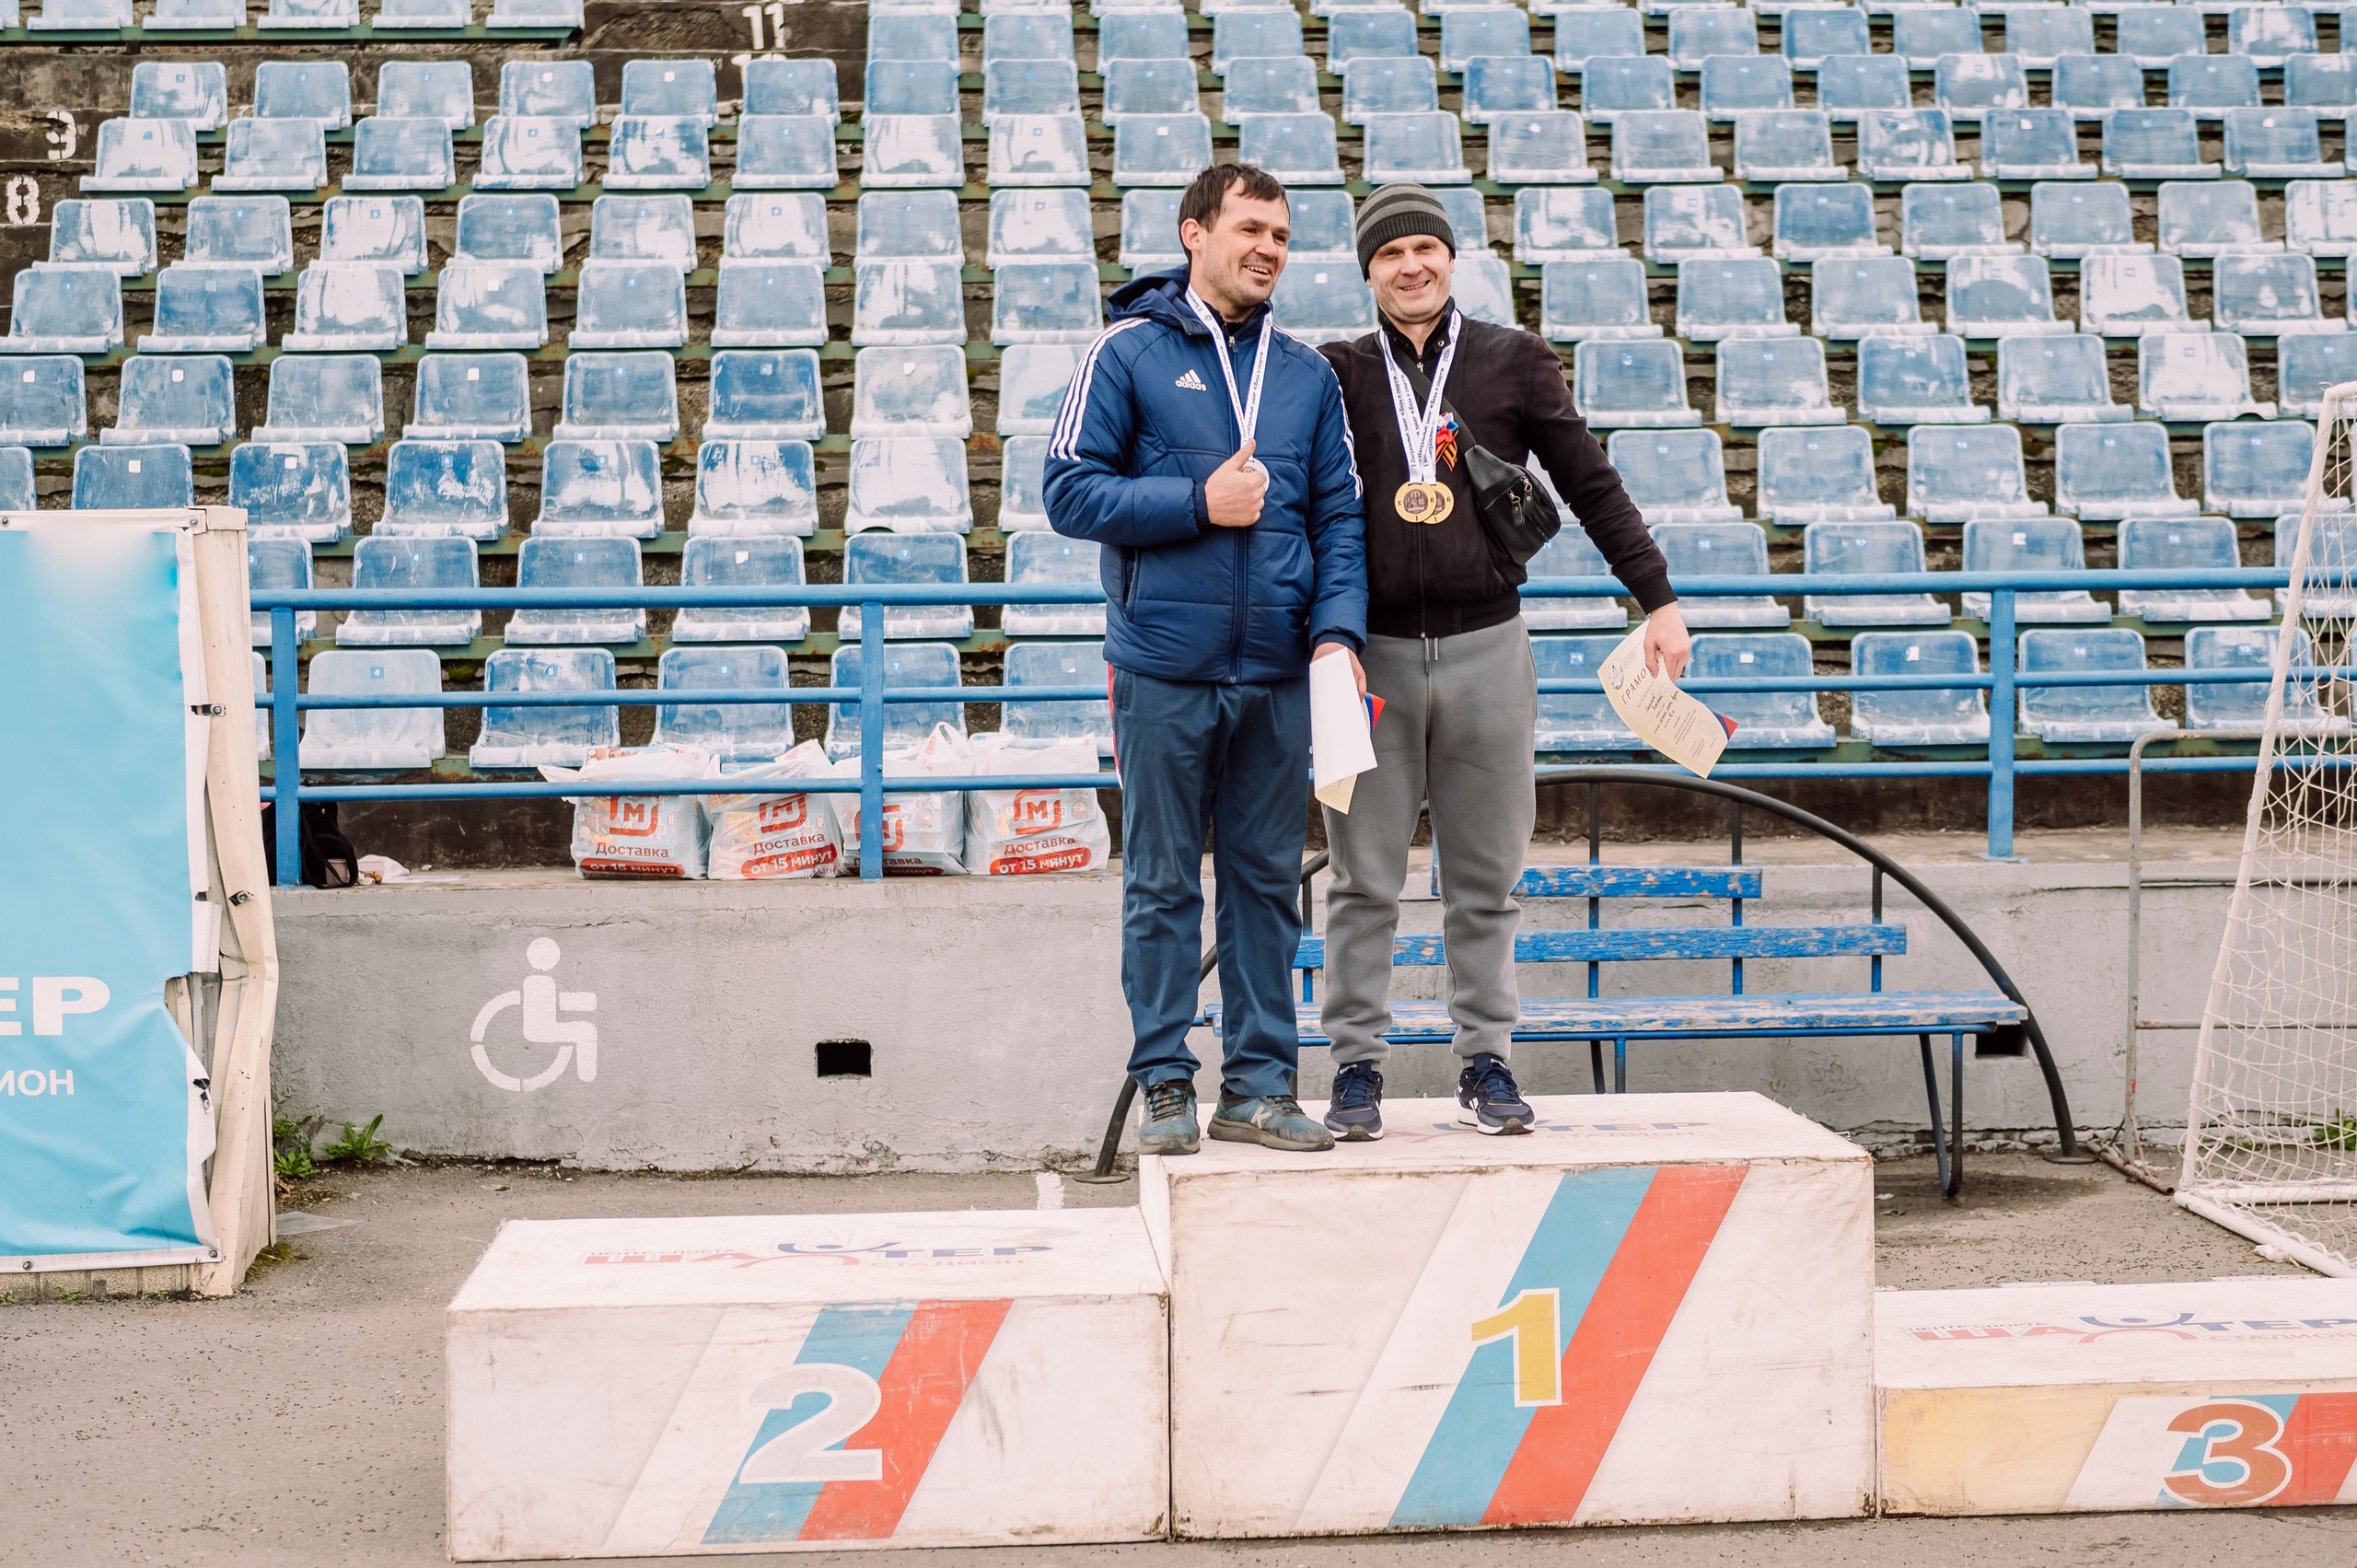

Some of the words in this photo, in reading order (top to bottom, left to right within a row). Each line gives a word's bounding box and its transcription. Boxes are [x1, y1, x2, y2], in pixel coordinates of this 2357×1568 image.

[742, 3, 784, 50] 11
[46, 111, 76, 160] 9
[6, 175, 41, 225] 8
[1175, 379, 1207, 391] adidas
[1621, 668, 1646, 705] ГРАМО
[596, 842, 669, 858] Доставка
[753, 832, 826, 854] Доставка
[1004, 837, 1075, 856] Доставка
[610, 863, 627, 872] 15
[631, 865, 676, 874] минут
[750, 863, 769, 875] от
[771, 858, 788, 869] 15
[790, 851, 834, 867] минут
[853, 857, 923, 867] Дтавка
[998, 863, 1016, 875] от
[1020, 858, 1037, 871] 15
[1039, 852, 1084, 869] минут
[872, 1259, 1024, 1267] СТАДИОН
[1470, 1287, 1562, 1408] 1
[739, 1363, 883, 1484] 2
[2163, 1398, 2293, 1506] 3
